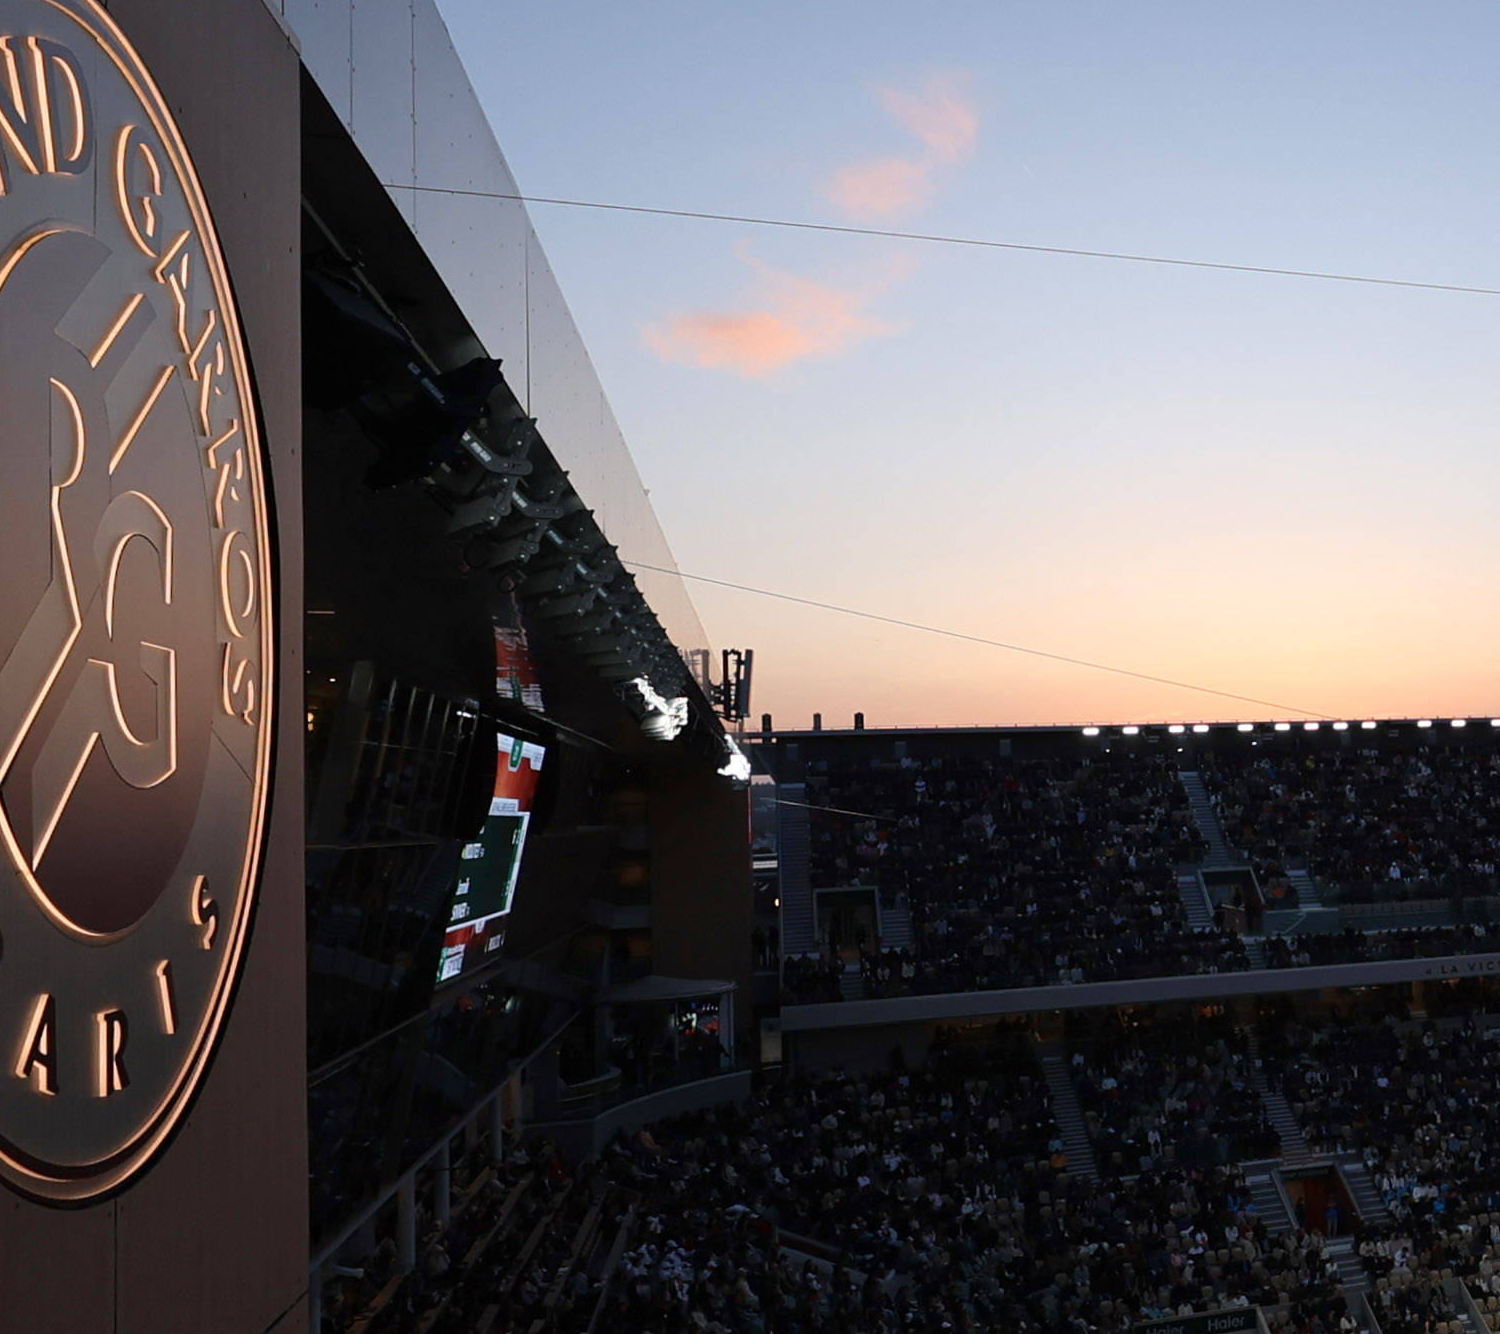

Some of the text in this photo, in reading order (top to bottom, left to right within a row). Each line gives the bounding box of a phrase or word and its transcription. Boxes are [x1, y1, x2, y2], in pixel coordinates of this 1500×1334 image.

[115, 124, 259, 727] GARROS
[1441, 965, 1458, 974] LA
[1207, 1315, 1245, 1331] Haier
